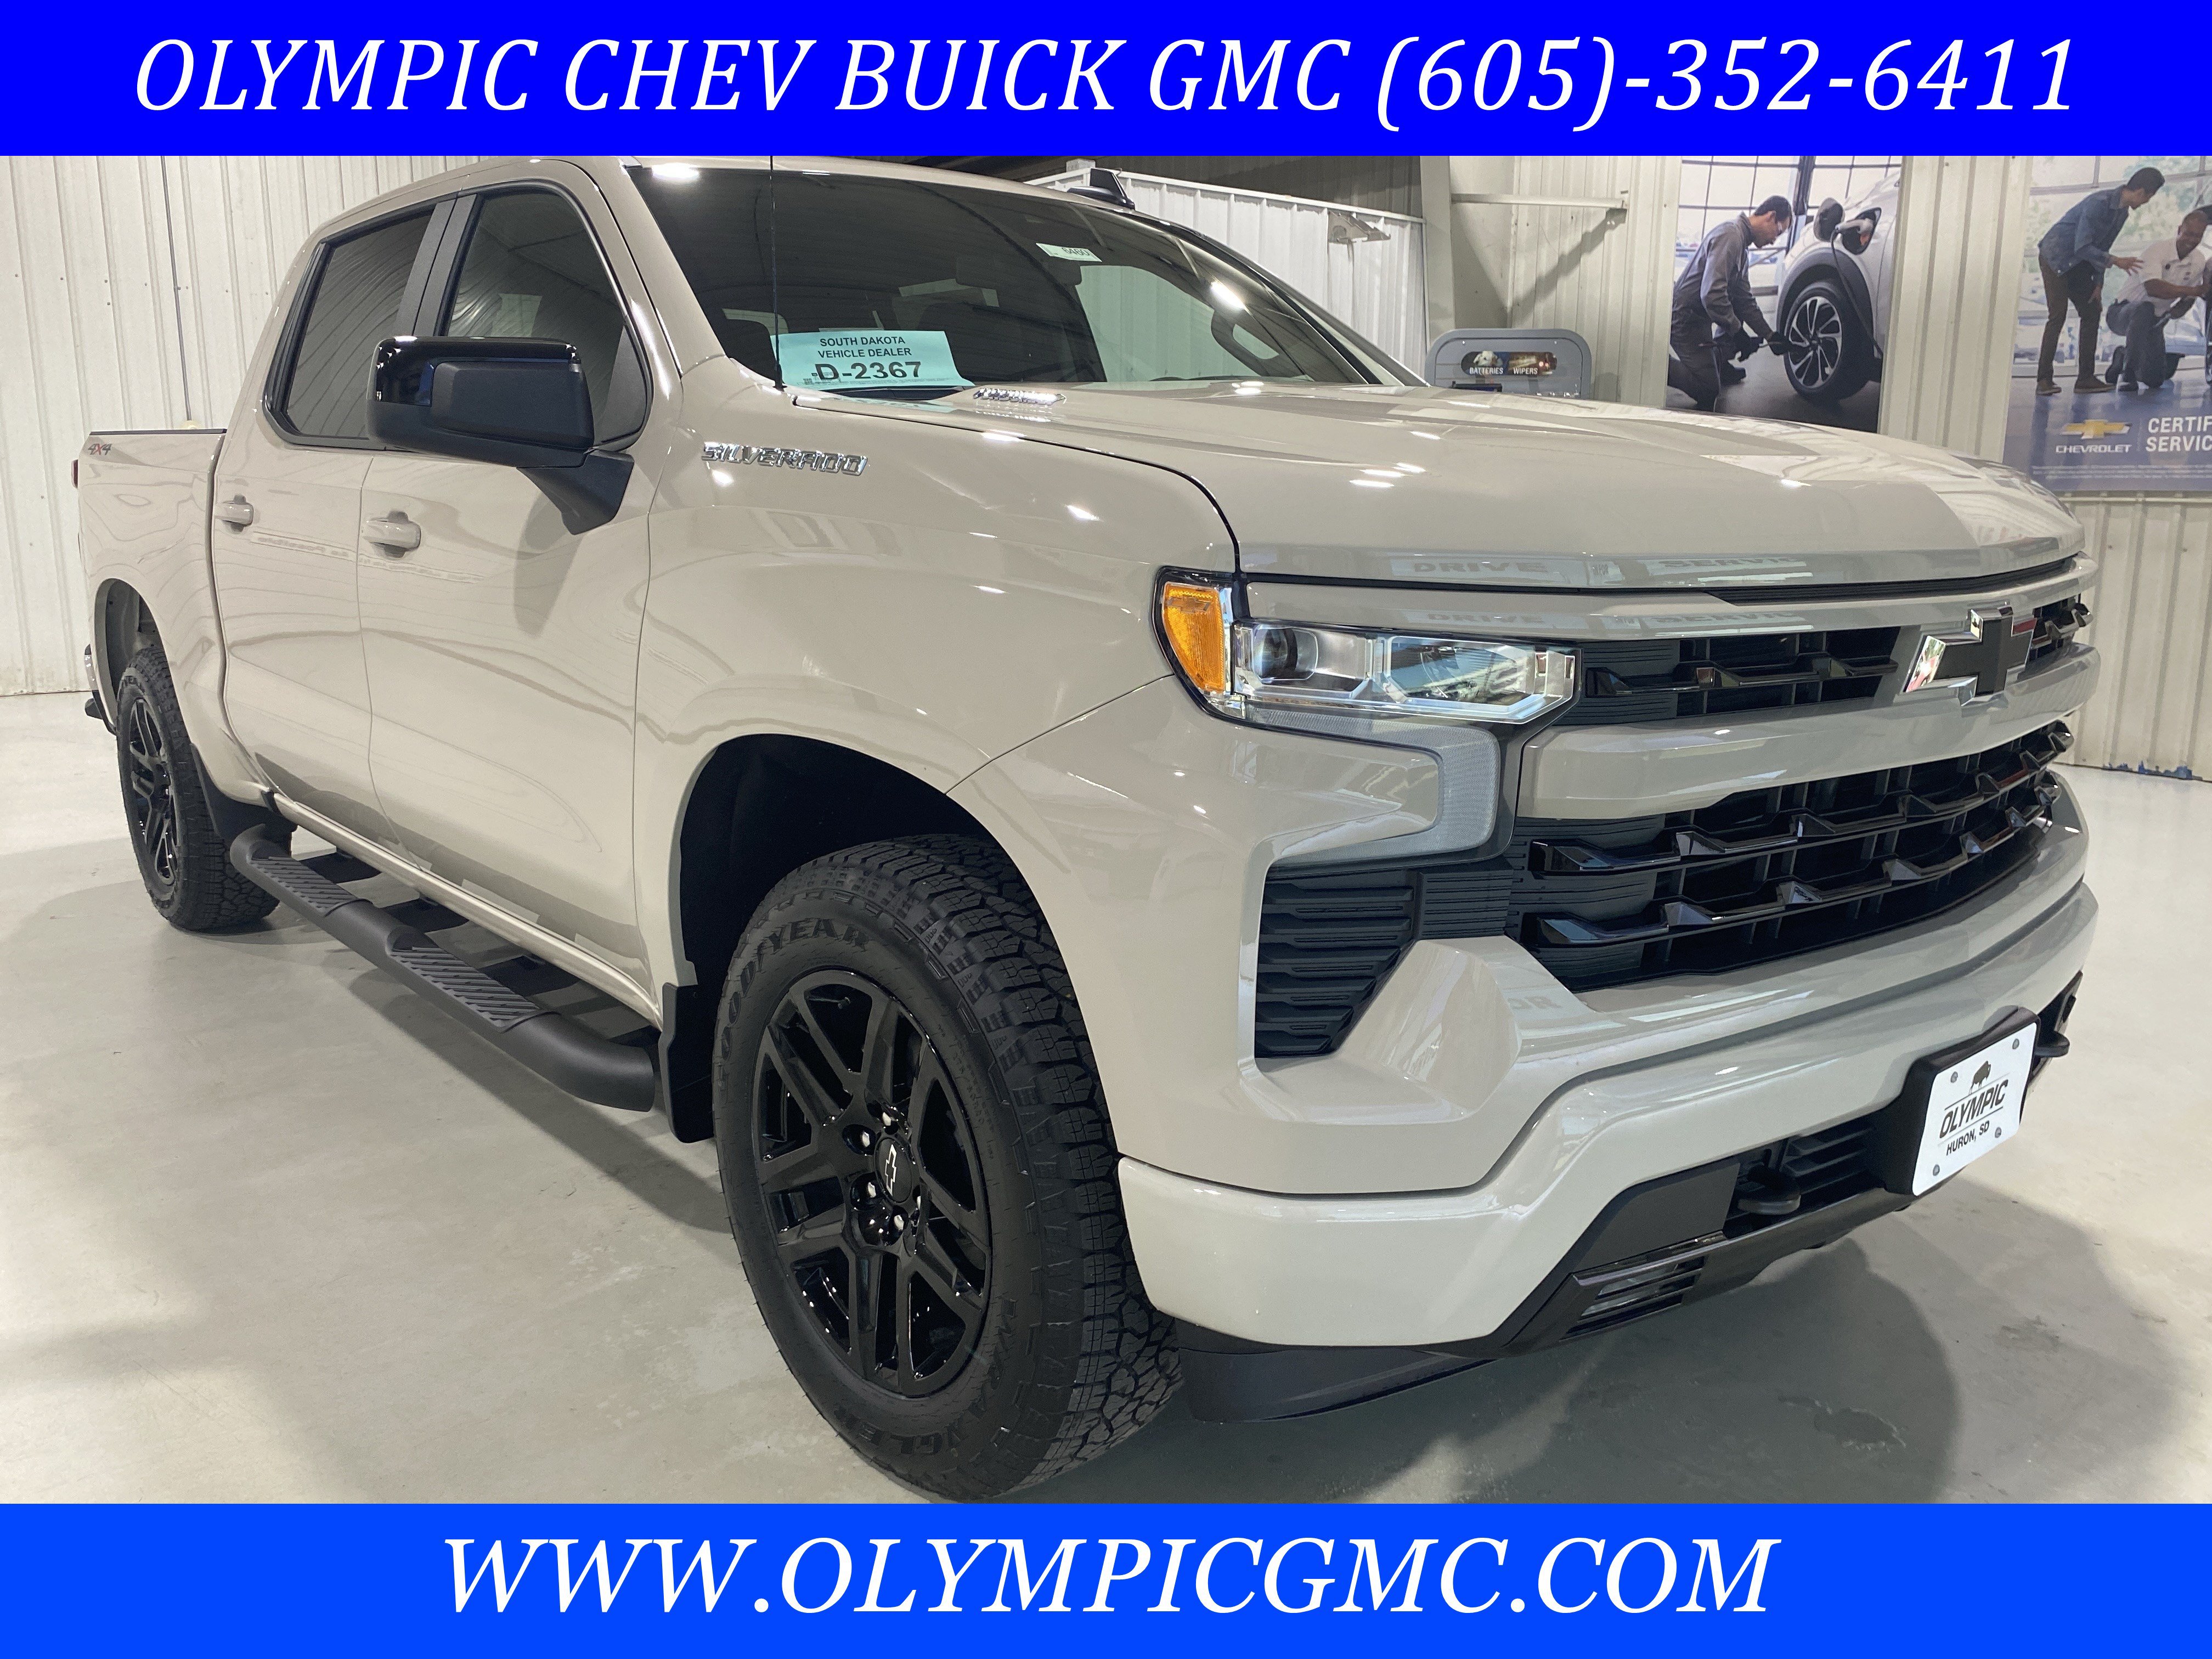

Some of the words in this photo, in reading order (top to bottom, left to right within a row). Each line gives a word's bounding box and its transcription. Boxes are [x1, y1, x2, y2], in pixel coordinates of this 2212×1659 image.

[820, 337, 858, 346] SOUTH
[861, 336, 906, 345] DAKOTA
[817, 349, 865, 358] VEHICLE
[868, 348, 912, 357] DEALER
[2148, 415, 2212, 433] CERTIF
[2055, 444, 2132, 453] CHEVROLET
[2145, 435, 2212, 452] SERVIC
[701, 442, 868, 476] SILVERADO
[1939, 1079, 2008, 1139] OLYMPIC
[1946, 1128, 1977, 1156] HURON,
[1979, 1120, 1990, 1136] SD
